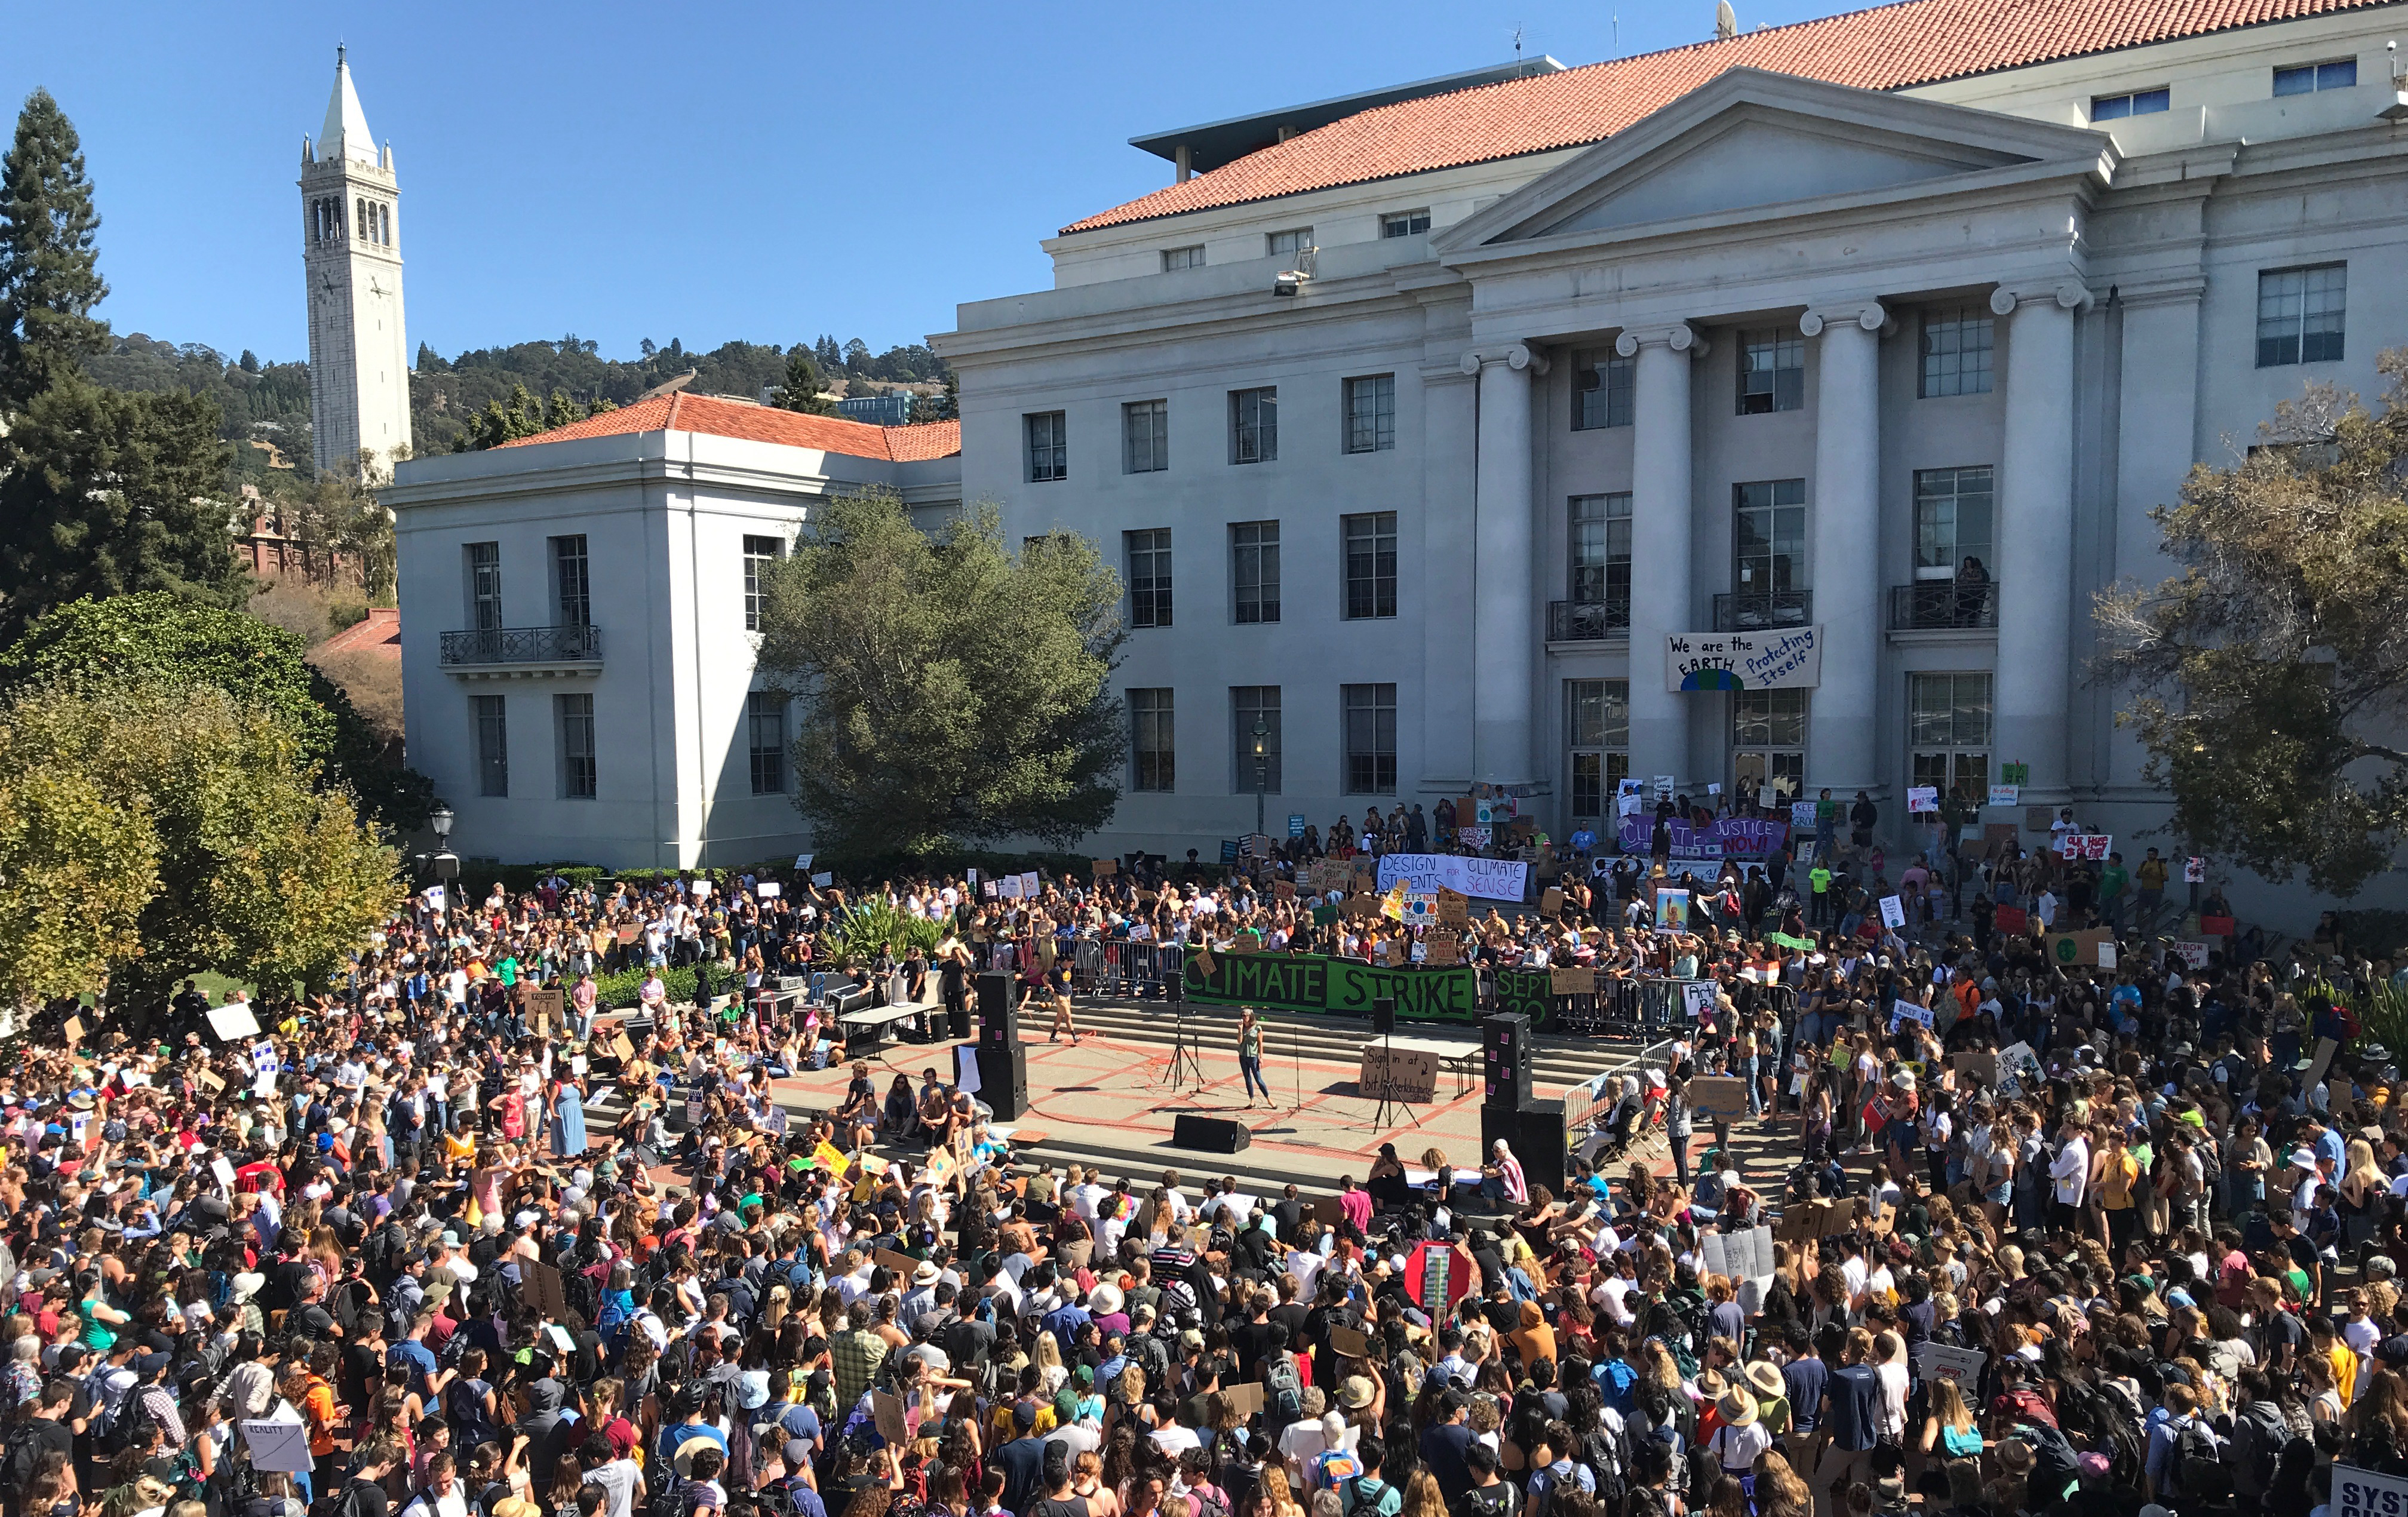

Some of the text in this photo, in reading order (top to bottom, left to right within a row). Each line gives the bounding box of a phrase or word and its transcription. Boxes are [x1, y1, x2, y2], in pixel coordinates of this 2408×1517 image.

[1670, 637, 1753, 652] We are the
[1746, 631, 1814, 674] Protecting
[1678, 658, 1735, 676] EARTH
[1759, 650, 1807, 686] Itself
[1716, 820, 1774, 836] JUSTICE
[1723, 836, 1768, 853] NOW!
[1383, 856, 1436, 873] DESIGN
[1467, 859, 1522, 879] CLIMATE
[1276, 884, 1294, 896] STOP
[1466, 875, 1519, 896] SENSE
[1405, 911, 1435, 923] TOO LATE
[1184, 956, 1467, 1014] CLIMATE STRIKE
[1497, 971, 1552, 999] SEPT
[1689, 985, 1713, 1000] Art
[1507, 999, 1546, 1025] 20
[1899, 1005, 1930, 1021] BEEF IS
[254, 1042, 270, 1052] UAW
[1368, 1048, 1419, 1069] Sign in at
[2003, 1061, 2022, 1075] FOR
[959, 1149, 973, 1165] IN
[1934, 1364, 1961, 1378] Valley
[248, 1425, 282, 1435] REALITY
